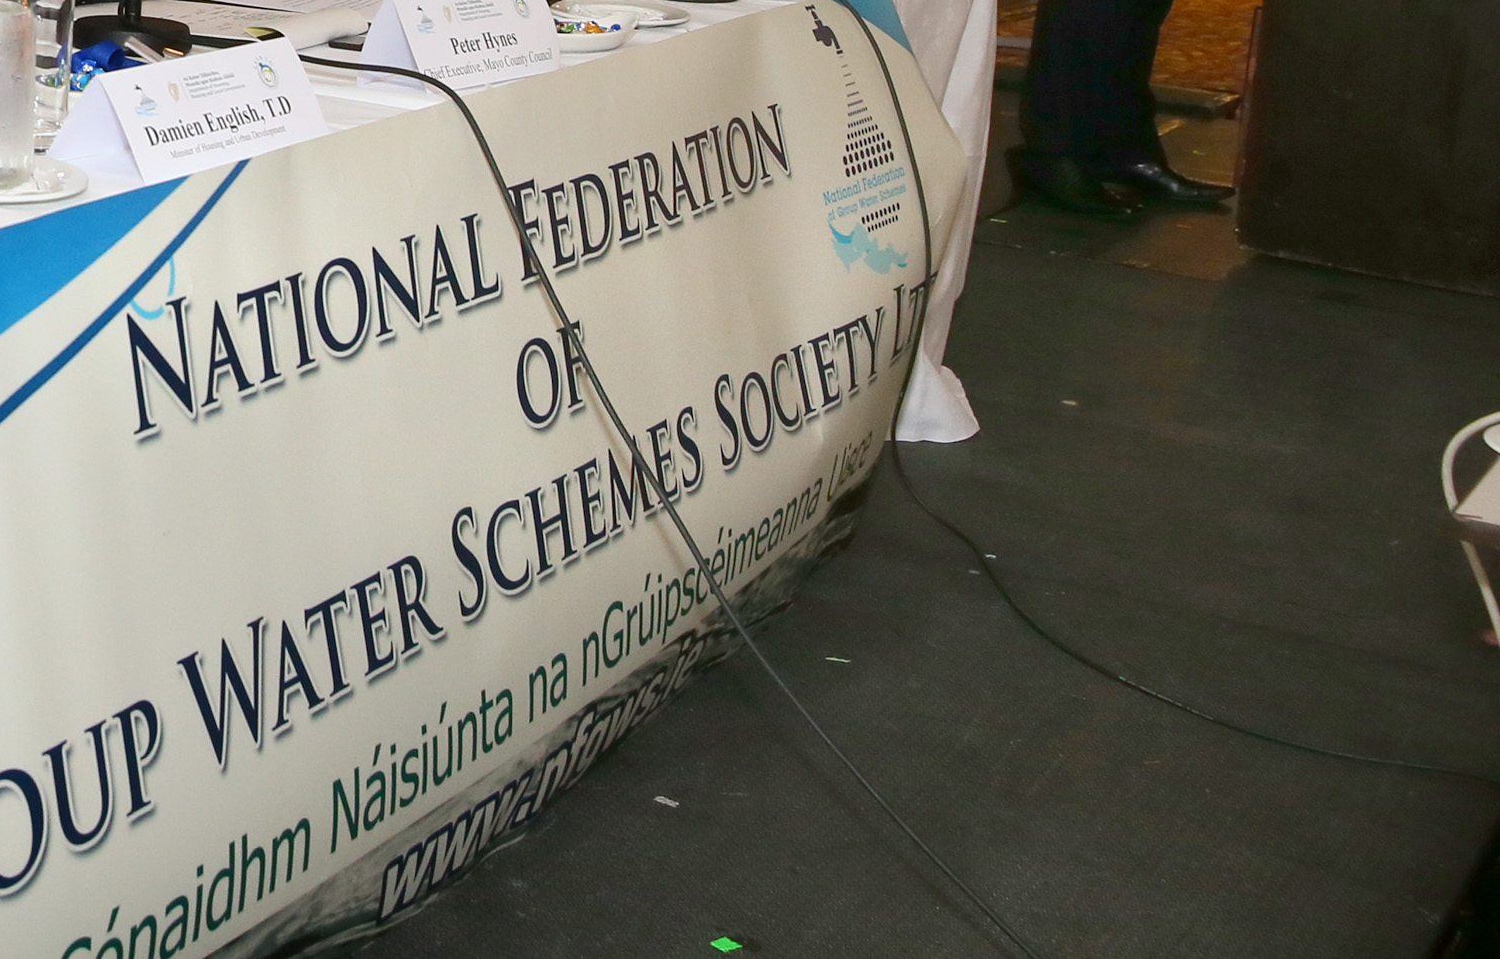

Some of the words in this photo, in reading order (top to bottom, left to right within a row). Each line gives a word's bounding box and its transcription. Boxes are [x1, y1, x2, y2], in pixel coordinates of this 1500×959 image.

[423, 65, 445, 80] Chief
[445, 60, 485, 78] Executive,
[482, 58, 505, 72] Mayo
[503, 54, 529, 68] County
[528, 47, 553, 63] Council
[450, 37, 481, 55] Peter
[481, 31, 519, 53] Hynes
[144, 119, 205, 147] Damien
[203, 103, 266, 134] English,
[262, 95, 292, 119] T.D
[822, 179, 861, 206] National
[861, 166, 906, 192] Federation
[836, 202, 859, 218] Group
[879, 184, 907, 201] Schemes
[125, 213, 500, 439] NATIONAL
[507, 103, 791, 284] FEDERATION
[516, 321, 586, 430] OF
[176, 554, 444, 773] WATER
[451, 405, 703, 621] SCHEMES
[713, 306, 886, 470] SOCIETY
[60, 817, 311, 959] ónaidhm
[330, 687, 513, 854] Náisiúnta
[528, 652, 568, 724] na
[582, 477, 823, 687] nGrúipscéimeanna
